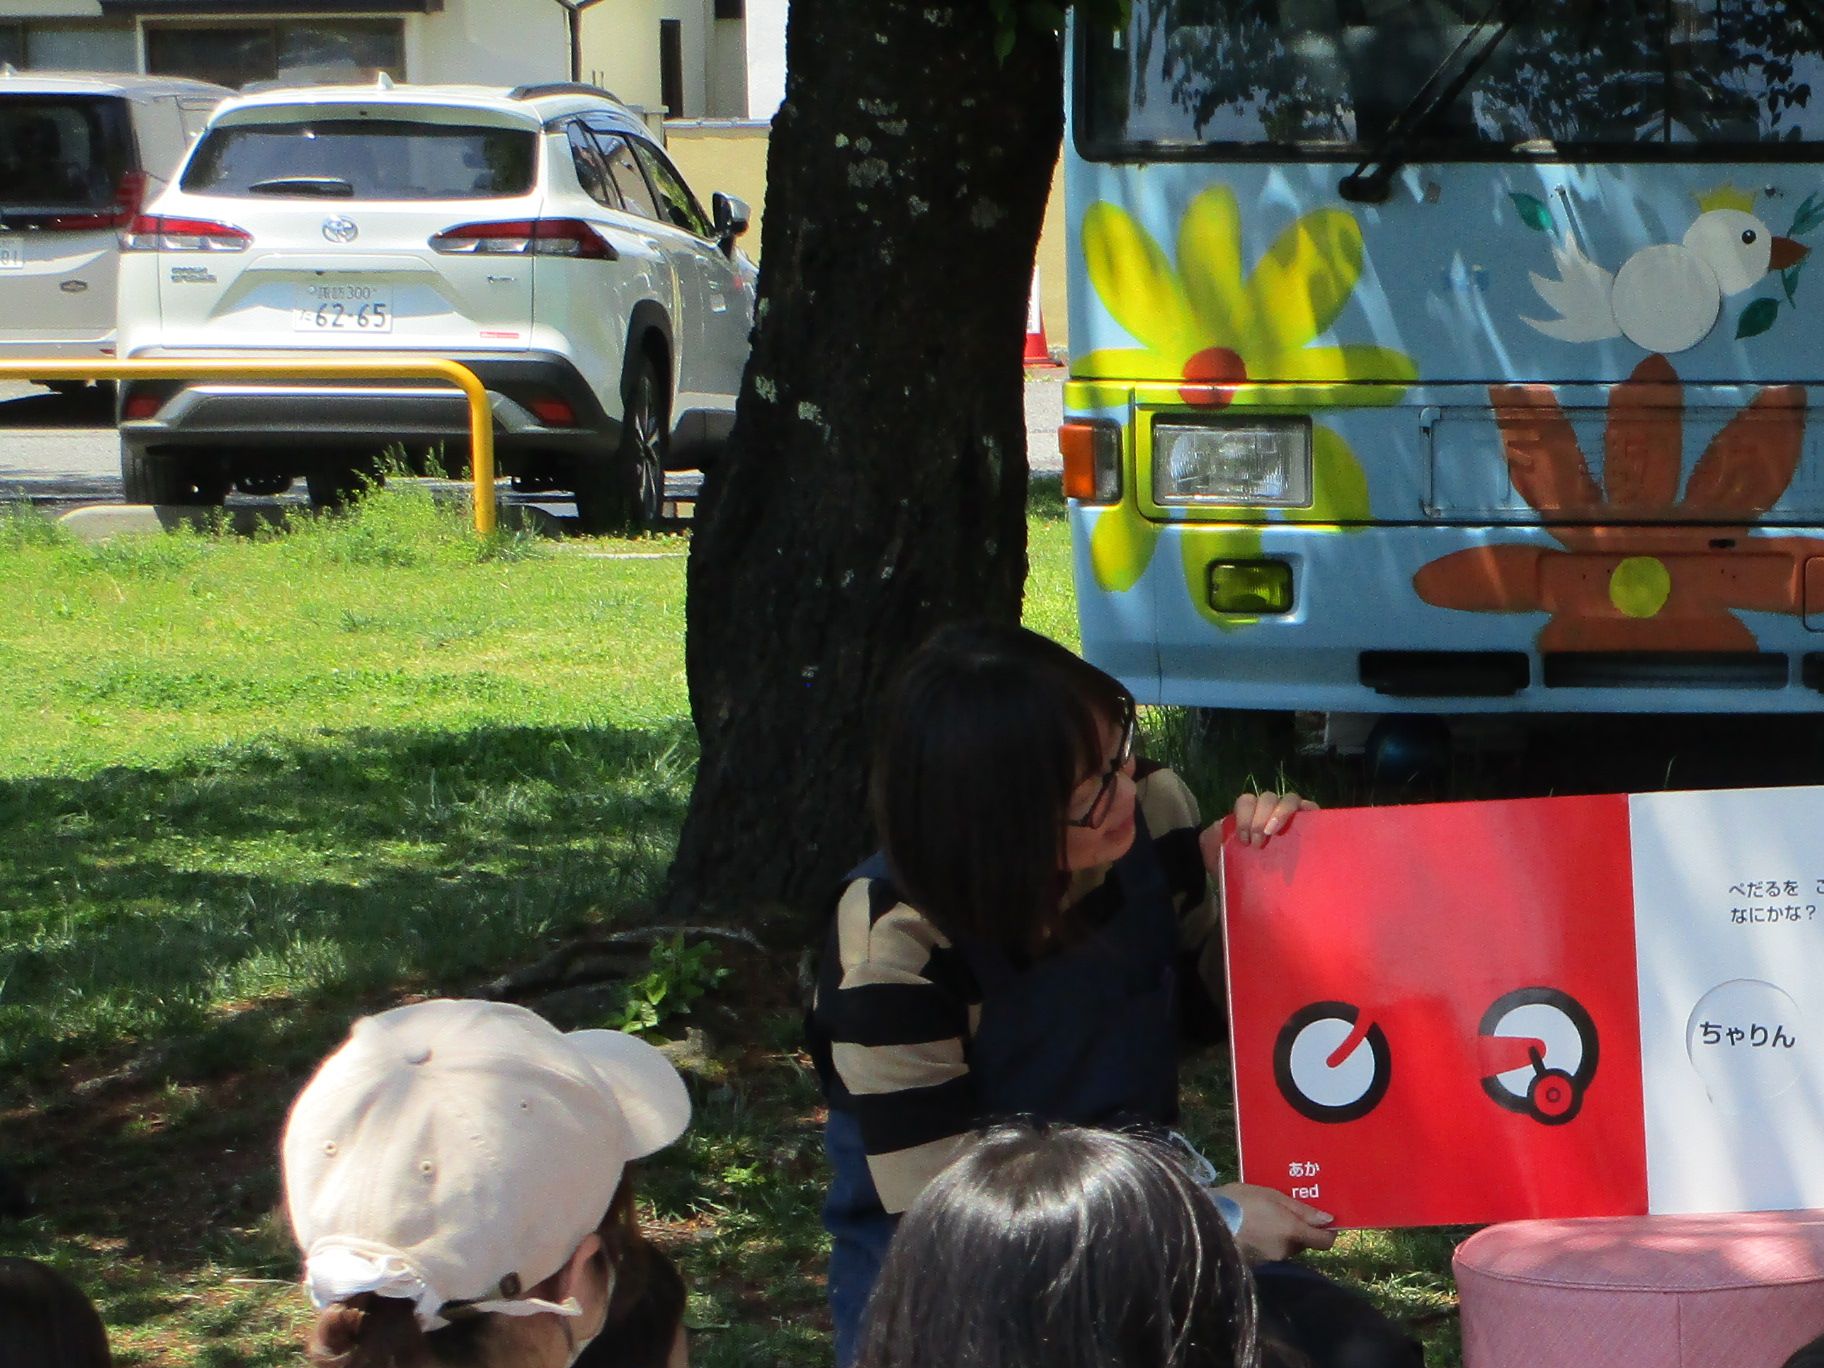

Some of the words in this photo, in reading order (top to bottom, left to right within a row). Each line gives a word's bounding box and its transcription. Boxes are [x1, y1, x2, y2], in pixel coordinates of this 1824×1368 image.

[315, 302, 387, 328] 62-65
[1699, 1020, 1796, 1049] ちゃりん
[1288, 1161, 1321, 1178] あか
[1291, 1183, 1320, 1199] red
